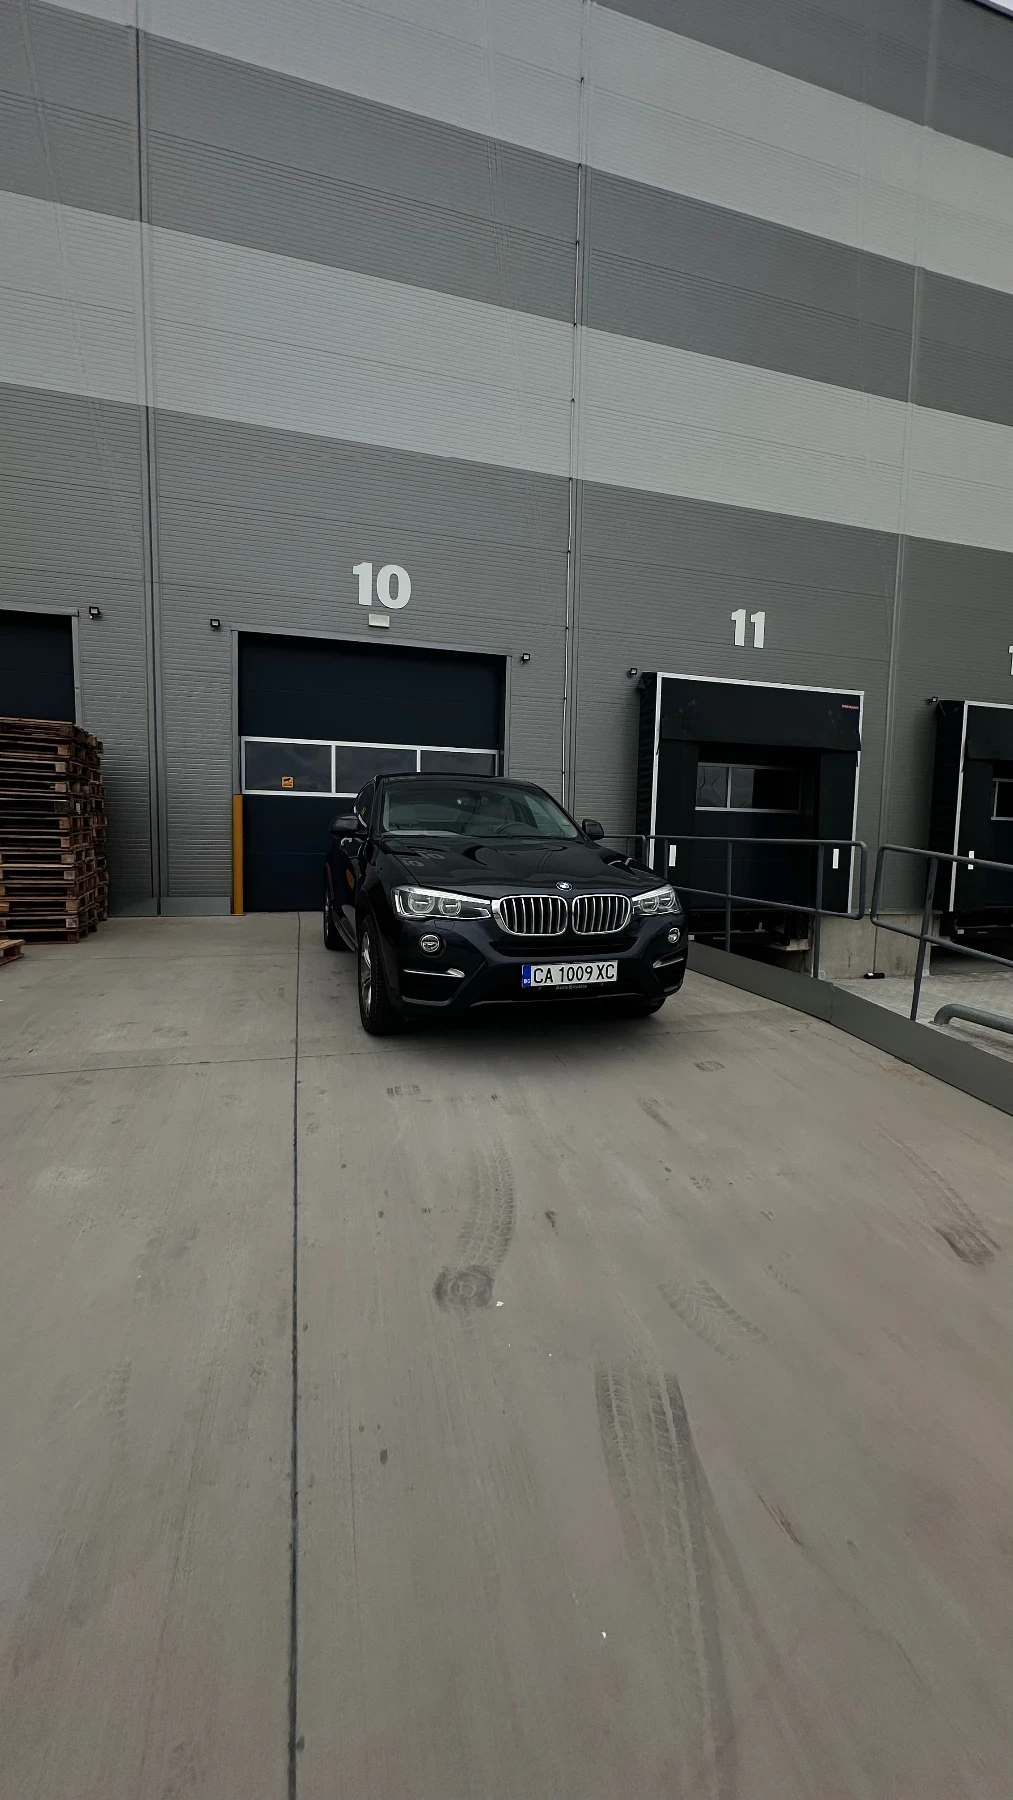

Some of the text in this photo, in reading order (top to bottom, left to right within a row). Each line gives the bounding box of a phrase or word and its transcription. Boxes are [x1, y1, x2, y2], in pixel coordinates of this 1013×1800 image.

[353, 562, 411, 609] 10
[731, 609, 765, 648] 11
[533, 963, 615, 984] CA 1009 XC
